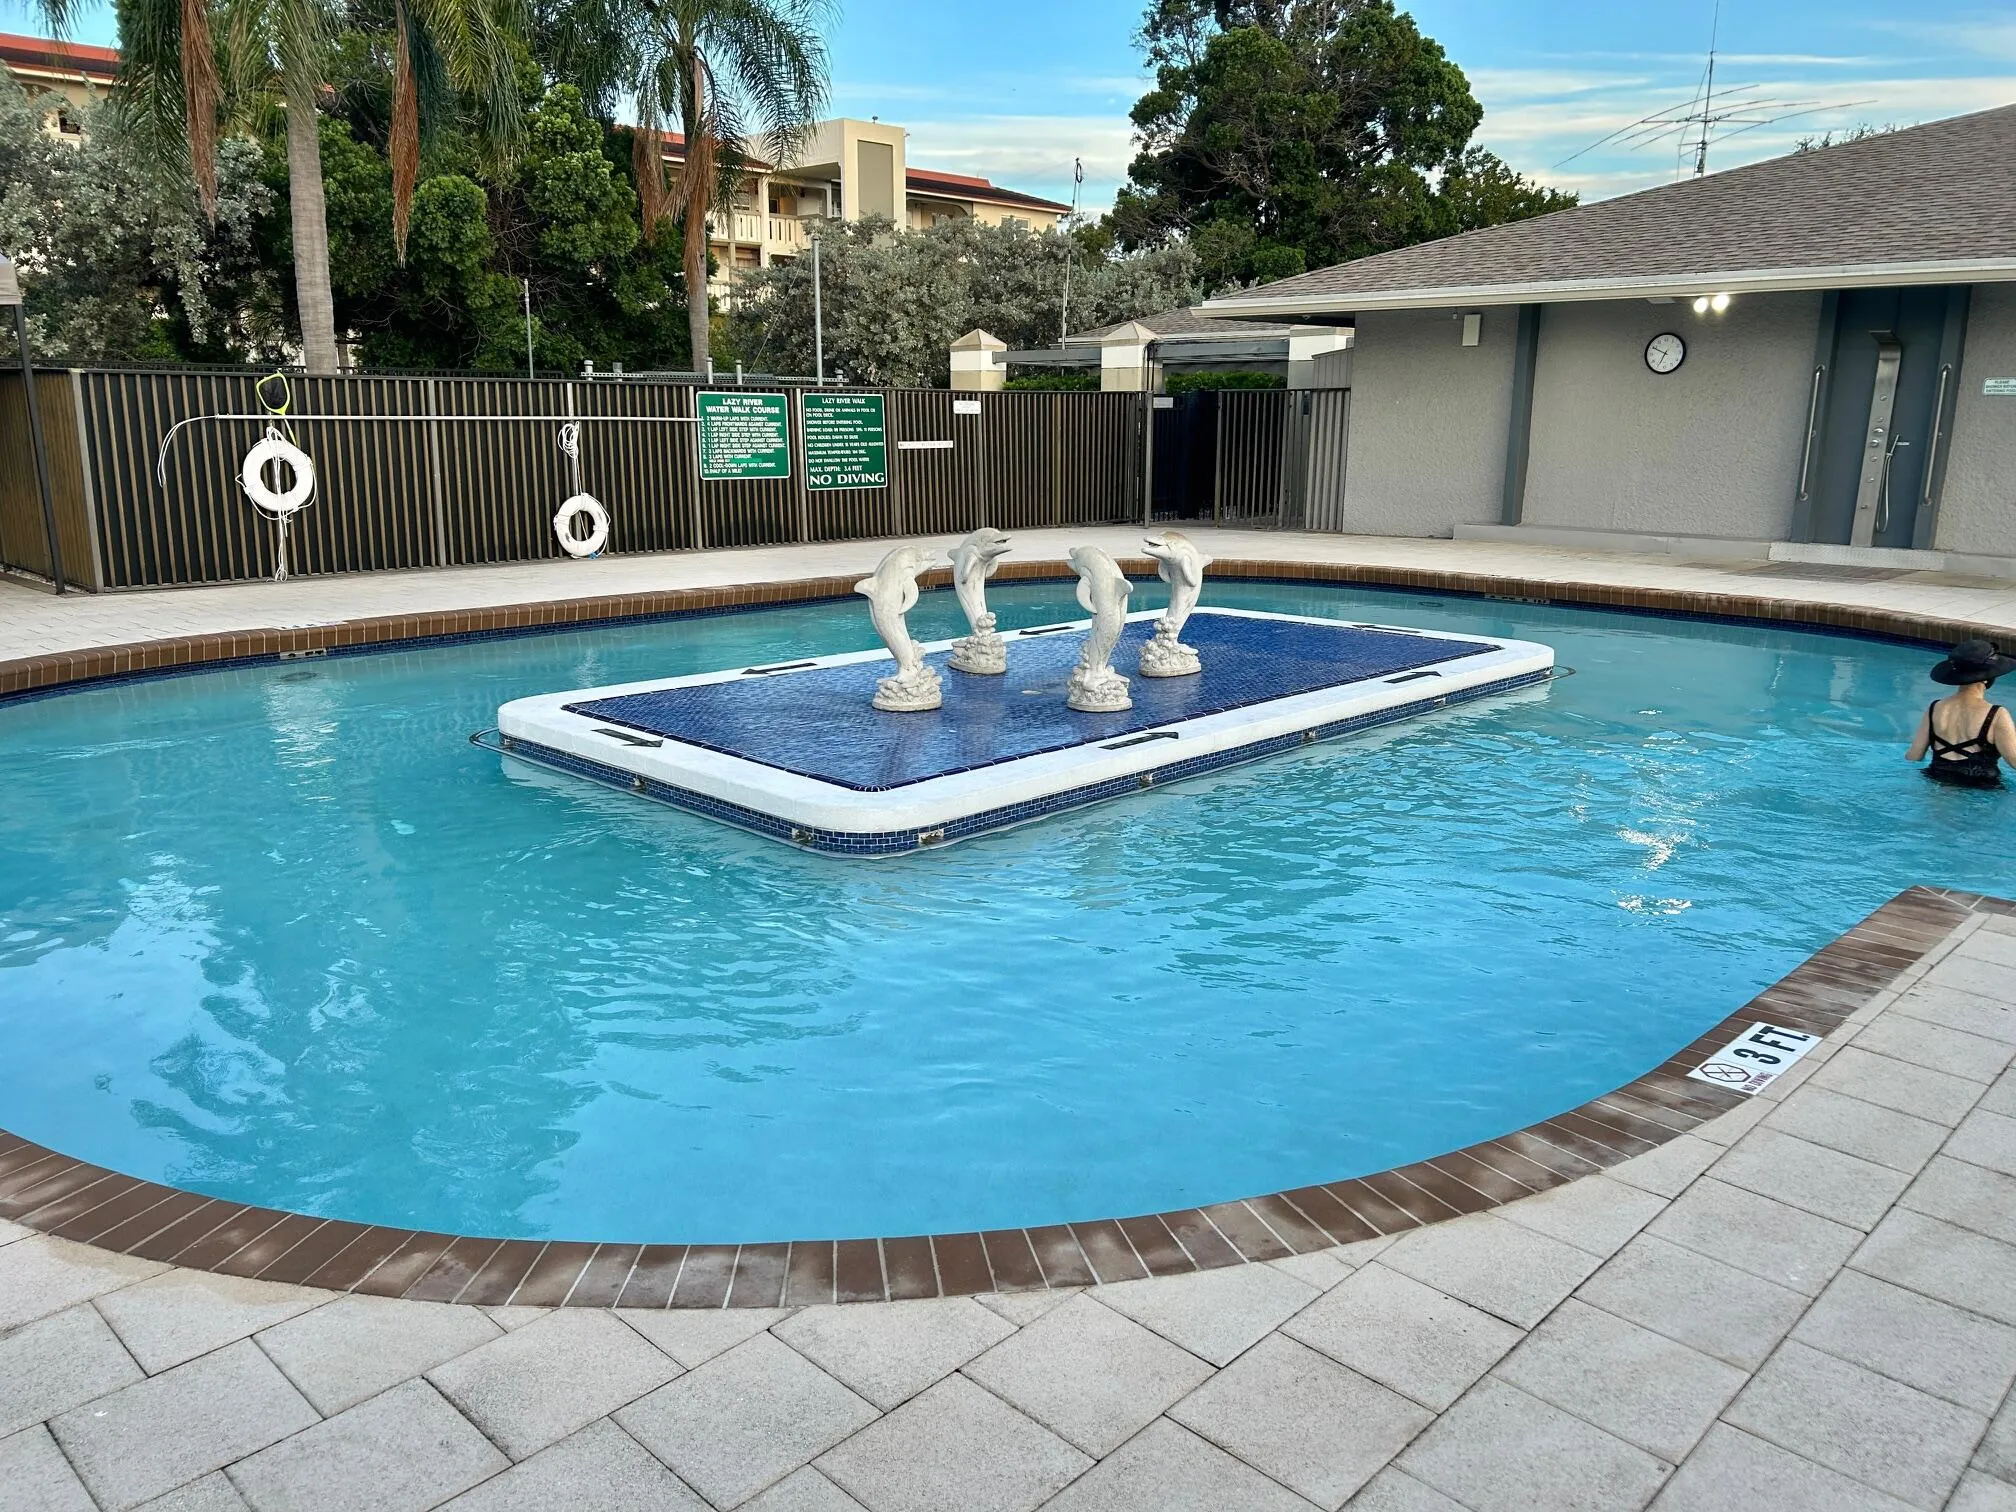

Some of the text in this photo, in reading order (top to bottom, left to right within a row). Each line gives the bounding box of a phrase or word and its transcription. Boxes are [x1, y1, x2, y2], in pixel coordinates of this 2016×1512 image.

[810, 473, 885, 485] NO DIVING
[1733, 1048, 1781, 1065] 3
[1740, 1072, 1773, 1091] NO DIVING
